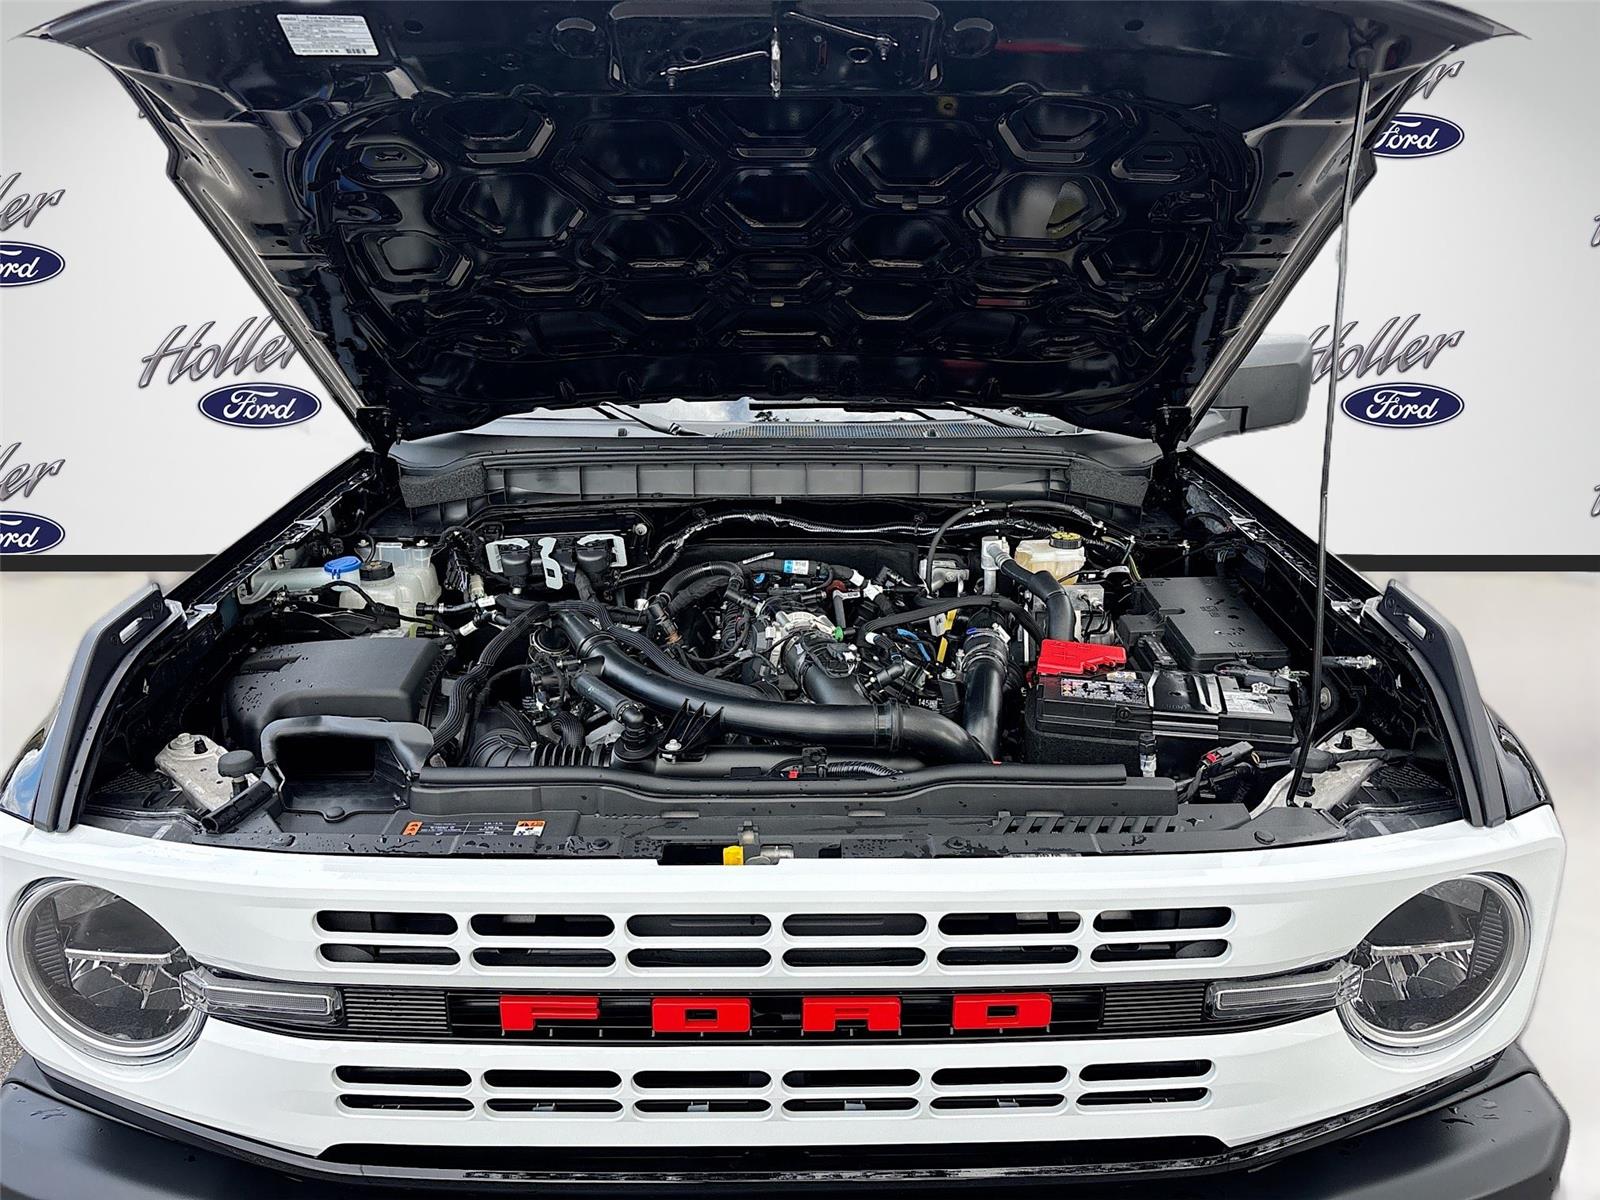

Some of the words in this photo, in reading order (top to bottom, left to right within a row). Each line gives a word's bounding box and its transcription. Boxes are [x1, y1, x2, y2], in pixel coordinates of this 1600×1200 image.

[1374, 120, 1440, 149] Ford
[223, 389, 297, 419] Ford
[1366, 389, 1440, 419] Ford
[500, 993, 1053, 1032] FORD
